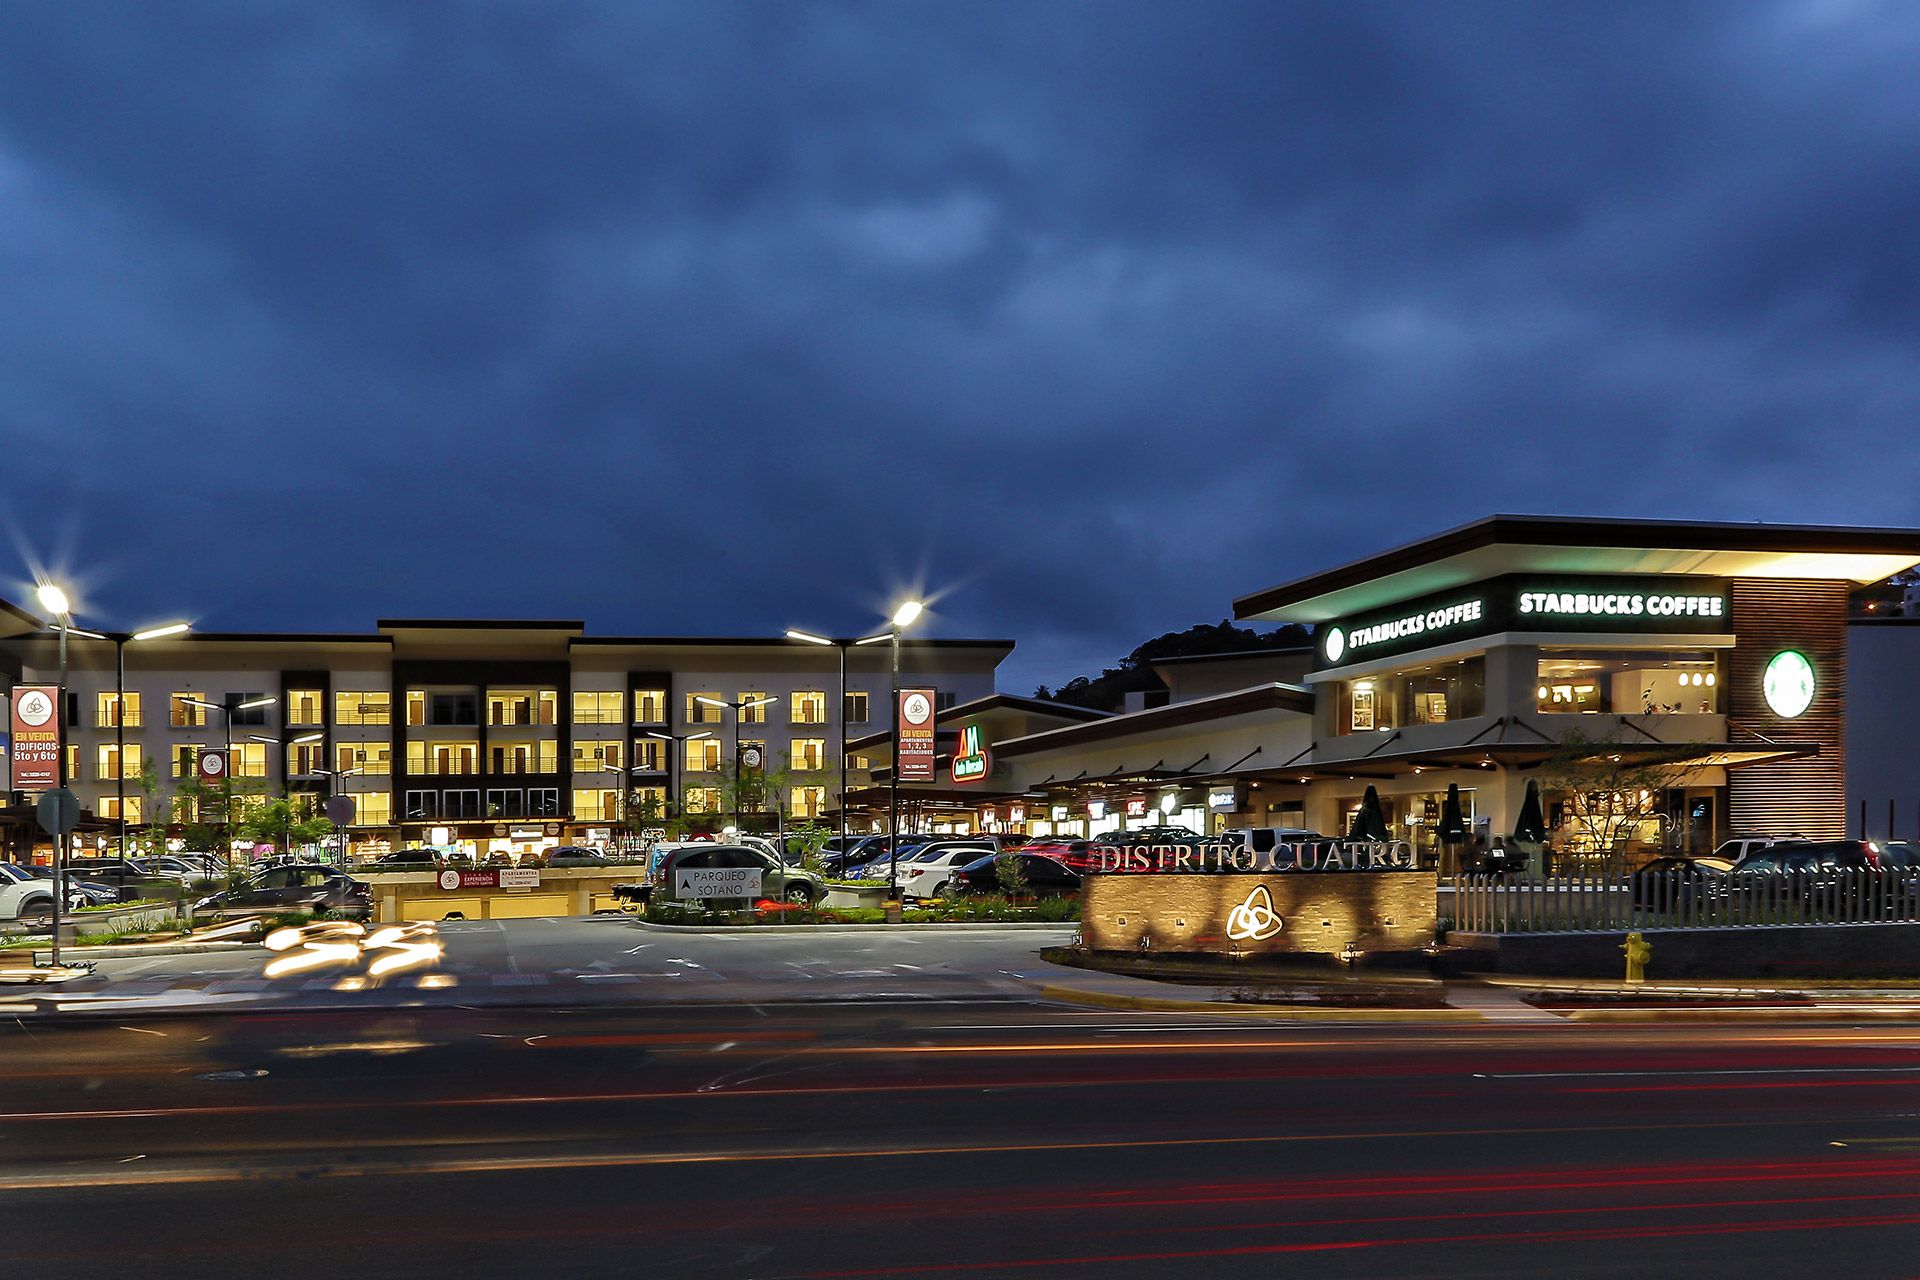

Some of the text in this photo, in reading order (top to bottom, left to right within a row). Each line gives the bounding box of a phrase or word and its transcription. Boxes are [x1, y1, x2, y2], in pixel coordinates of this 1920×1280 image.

[1520, 593, 1723, 616] STARBUCKS COFFEE
[1349, 600, 1482, 649] STARBUCKS COFFEE
[15, 732, 55, 740] EN VENTA
[911, 729, 932, 738] VENTA
[14, 752, 56, 761] 5to y 6to
[1100, 842, 1414, 872] DISTRITO CUATRO
[693, 871, 746, 881] PARQUEO
[698, 884, 743, 896] SÓTANO
